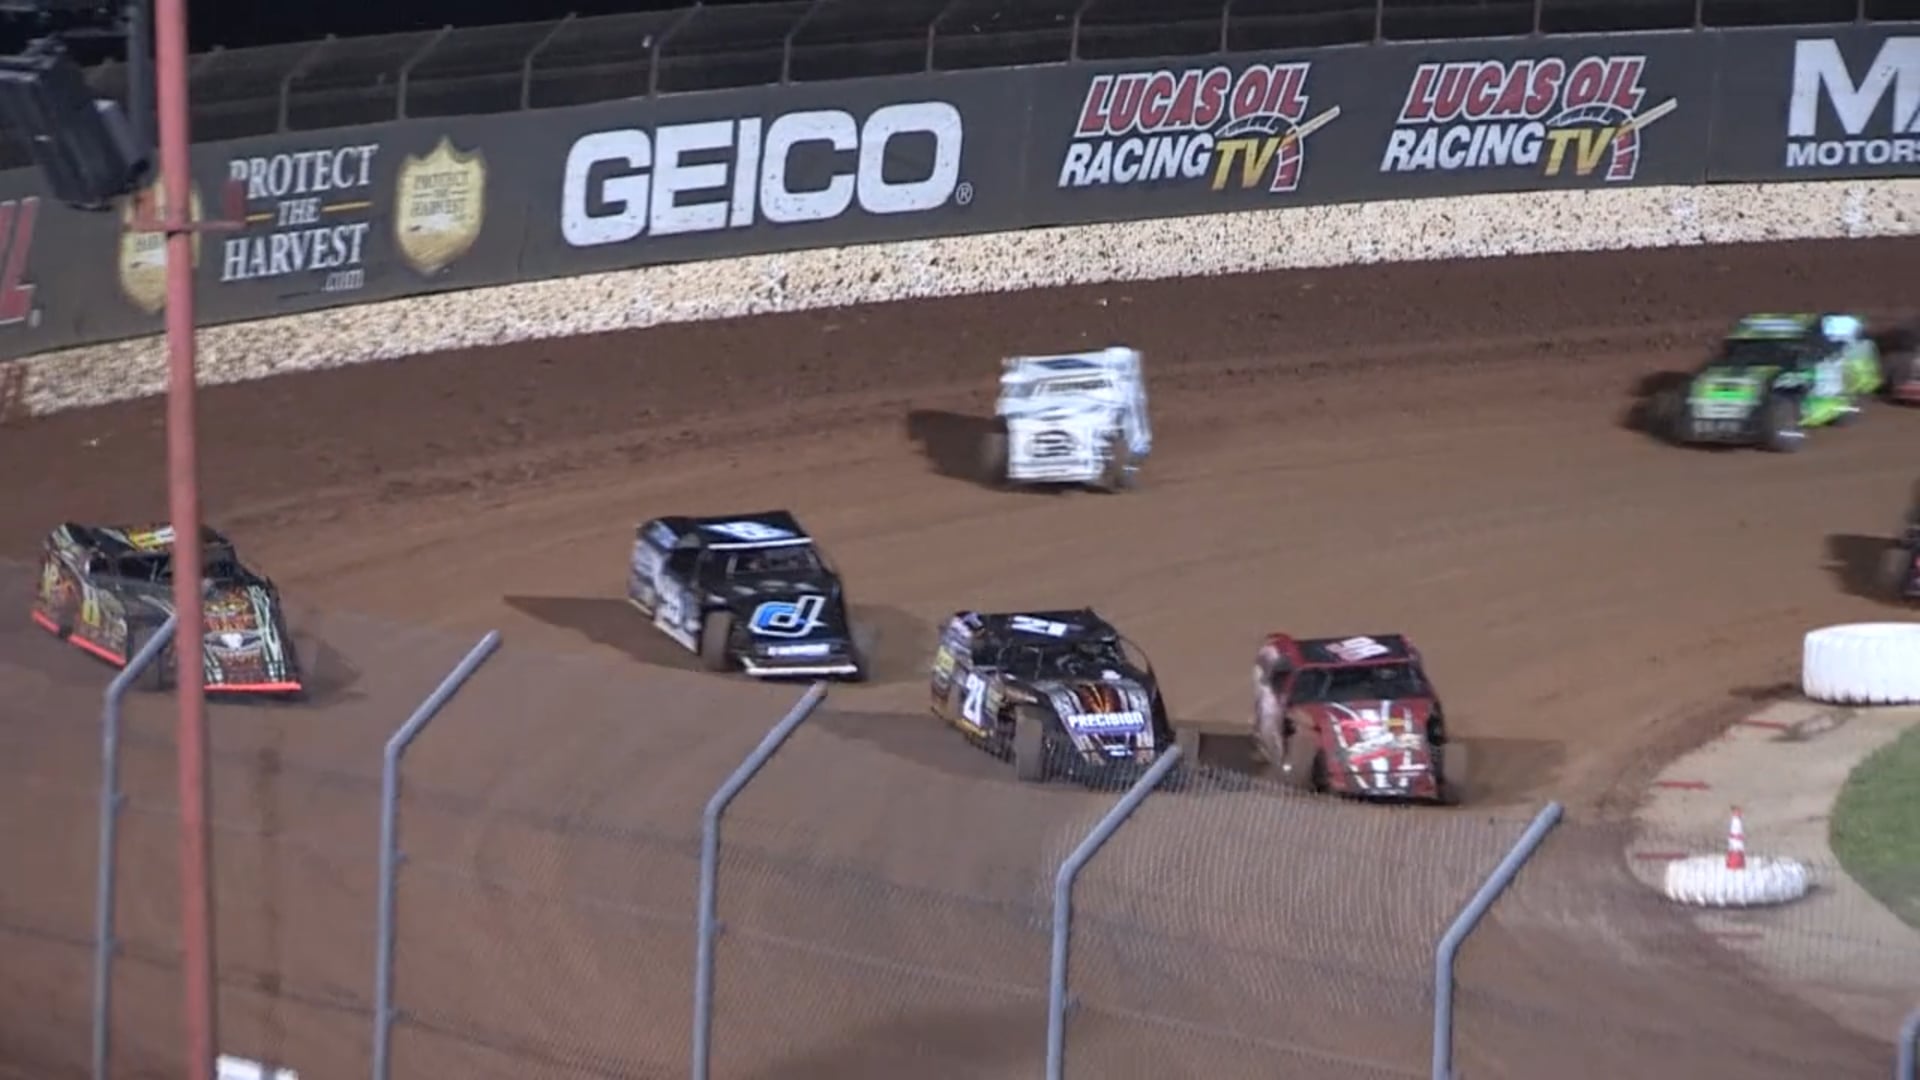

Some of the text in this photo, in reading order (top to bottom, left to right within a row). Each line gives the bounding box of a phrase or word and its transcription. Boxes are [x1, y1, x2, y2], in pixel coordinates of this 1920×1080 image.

[1075, 62, 1312, 137] LUCAS OIL
[1398, 55, 1647, 123] LUCAS OIL
[1788, 35, 1920, 137] M
[229, 144, 379, 199] PROTECT
[1058, 133, 1214, 187] RACING
[1380, 122, 1546, 172] RACING
[277, 197, 321, 226] THE
[220, 223, 370, 282] HARVEST
[1067, 711, 1145, 730] PRECISION
